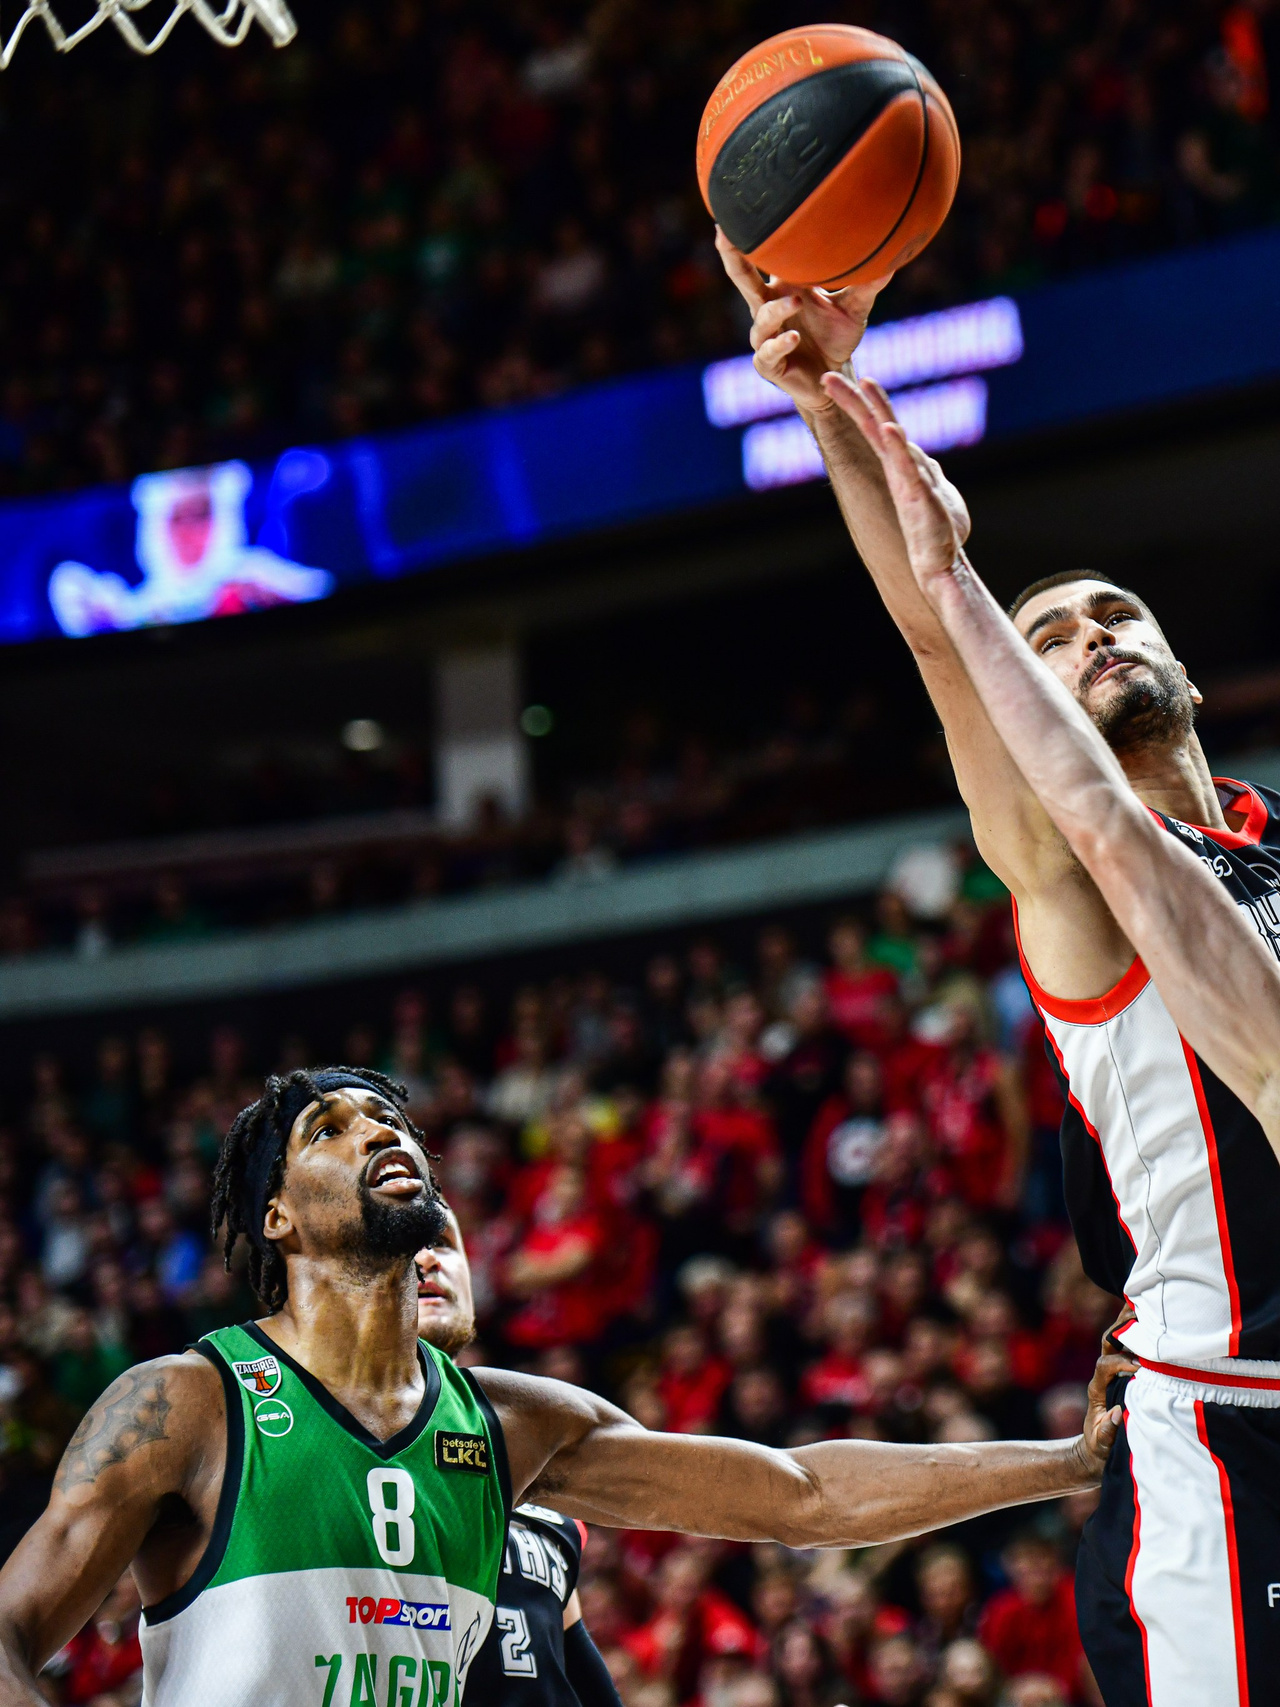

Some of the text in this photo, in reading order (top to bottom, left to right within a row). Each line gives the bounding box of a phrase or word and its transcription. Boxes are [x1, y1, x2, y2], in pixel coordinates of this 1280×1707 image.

[442, 1437, 479, 1450] betsafe
[442, 1446, 487, 1468] LKL
[366, 1467, 416, 1566] 8
[496, 1606, 538, 1679] 2
